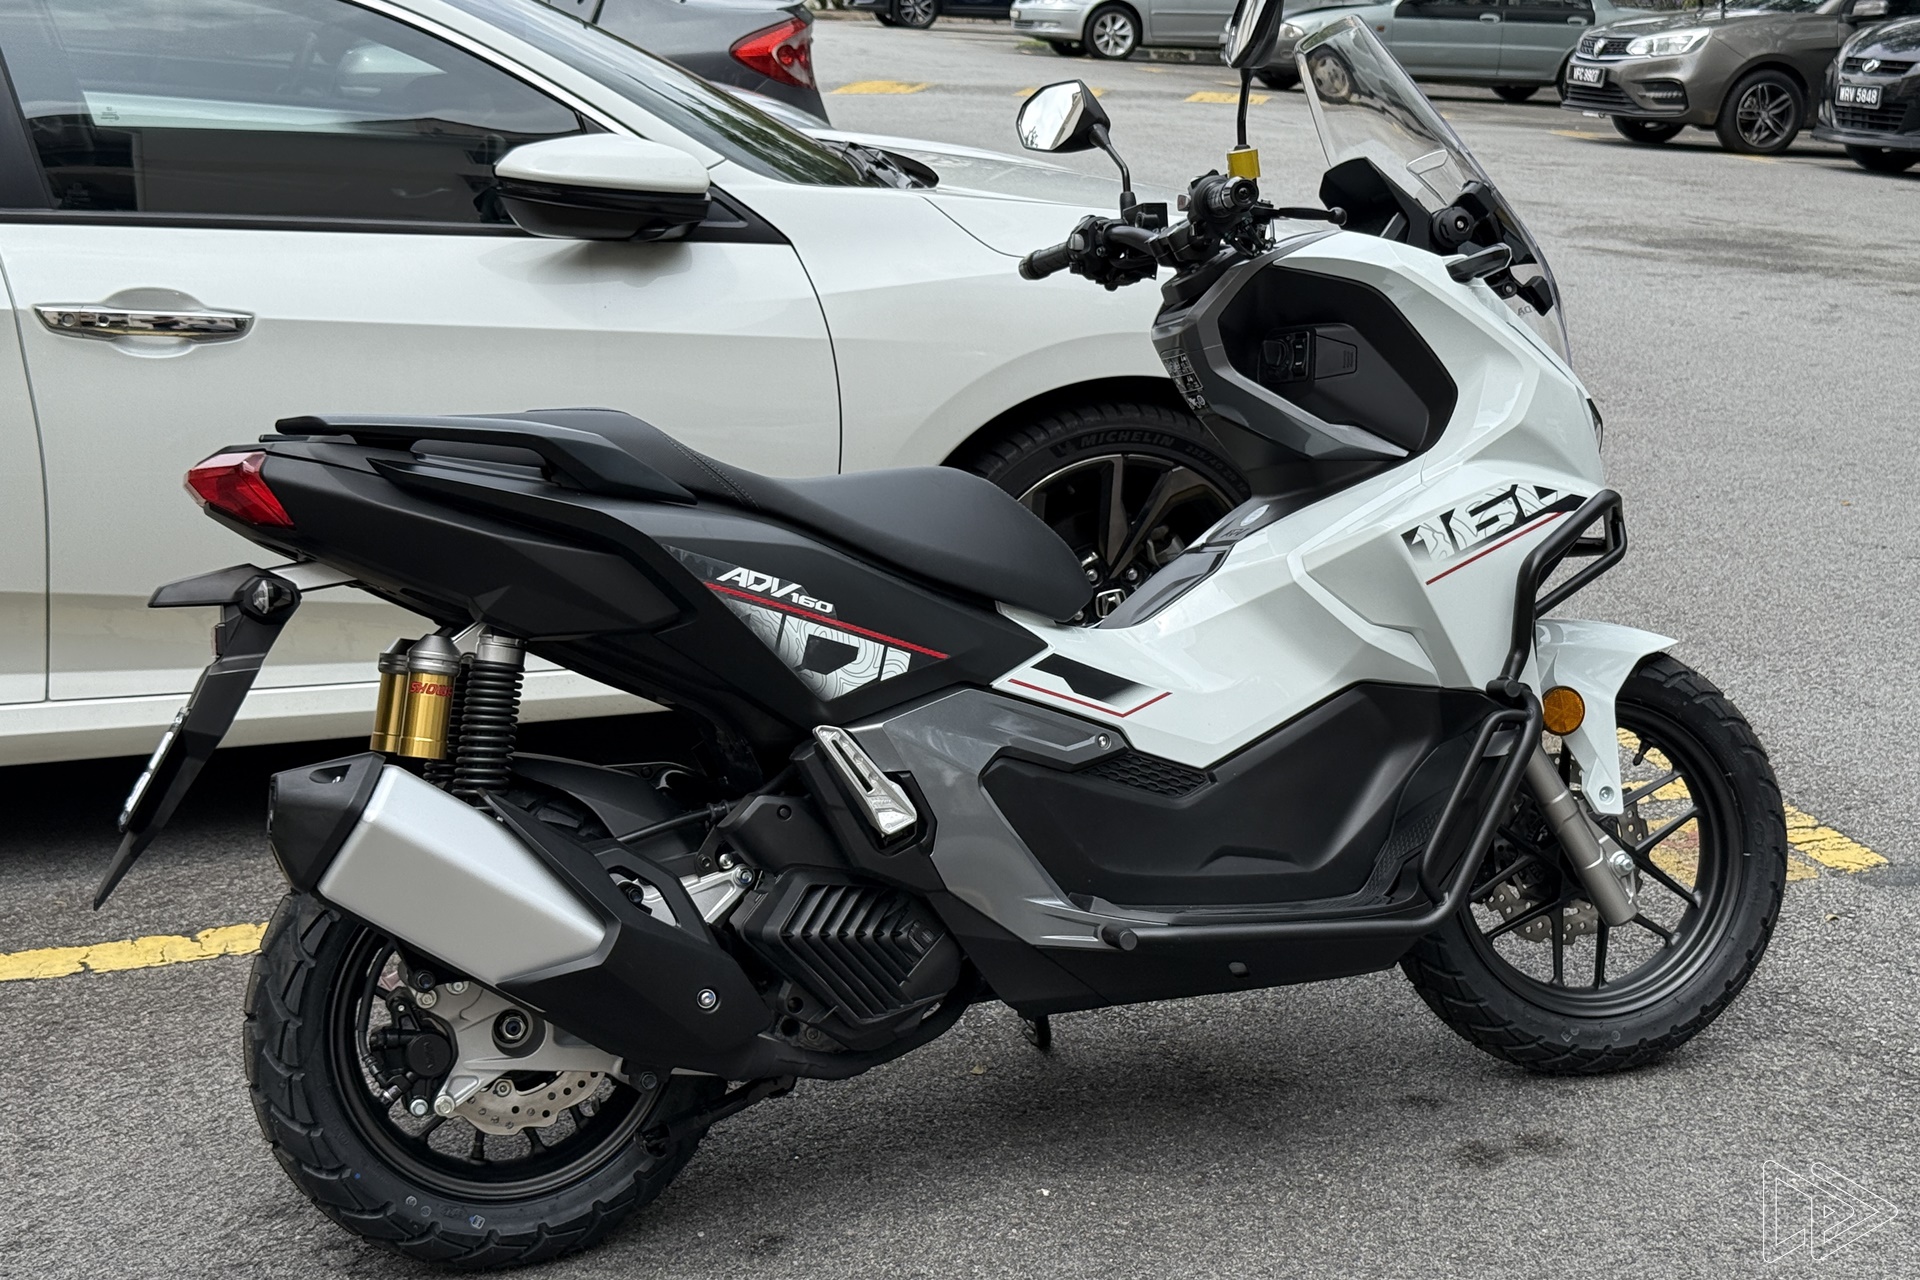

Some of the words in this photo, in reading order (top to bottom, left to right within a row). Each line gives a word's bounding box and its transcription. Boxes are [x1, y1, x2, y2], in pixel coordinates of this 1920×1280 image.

[1839, 86, 1855, 102] WRV
[1855, 87, 1878, 104] 5848
[1080, 431, 1175, 448] MICHELIN
[716, 566, 802, 598] ADV
[790, 592, 834, 613] 160
